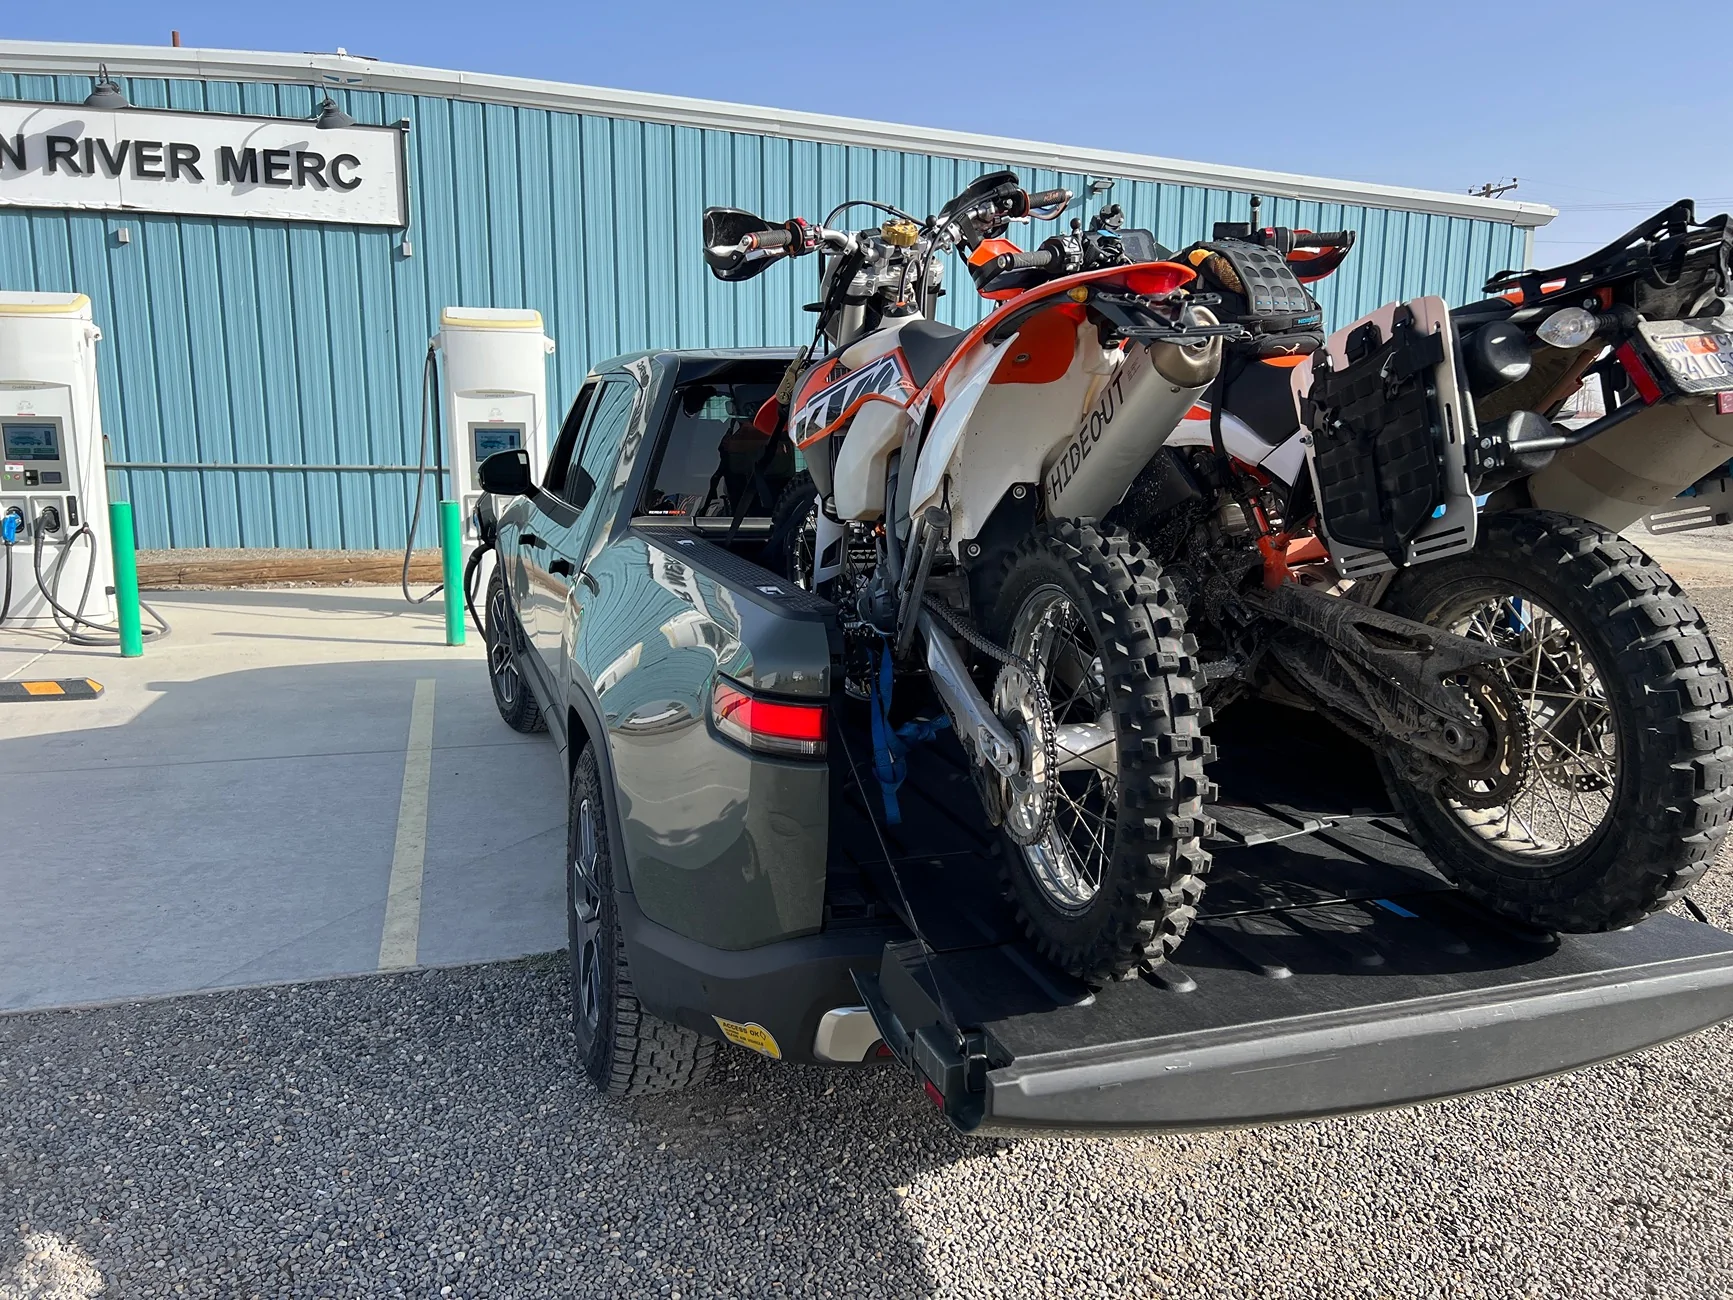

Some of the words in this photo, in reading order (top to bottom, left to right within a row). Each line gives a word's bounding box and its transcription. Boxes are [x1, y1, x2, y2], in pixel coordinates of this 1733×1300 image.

[46, 134, 205, 181] RIVER
[220, 145, 362, 190] MERC
[1664, 340, 1688, 353] JUN
[1050, 369, 1124, 501] HIDEOUT
[722, 1022, 748, 1034] ACCESS
[749, 1029, 760, 1037] OK
